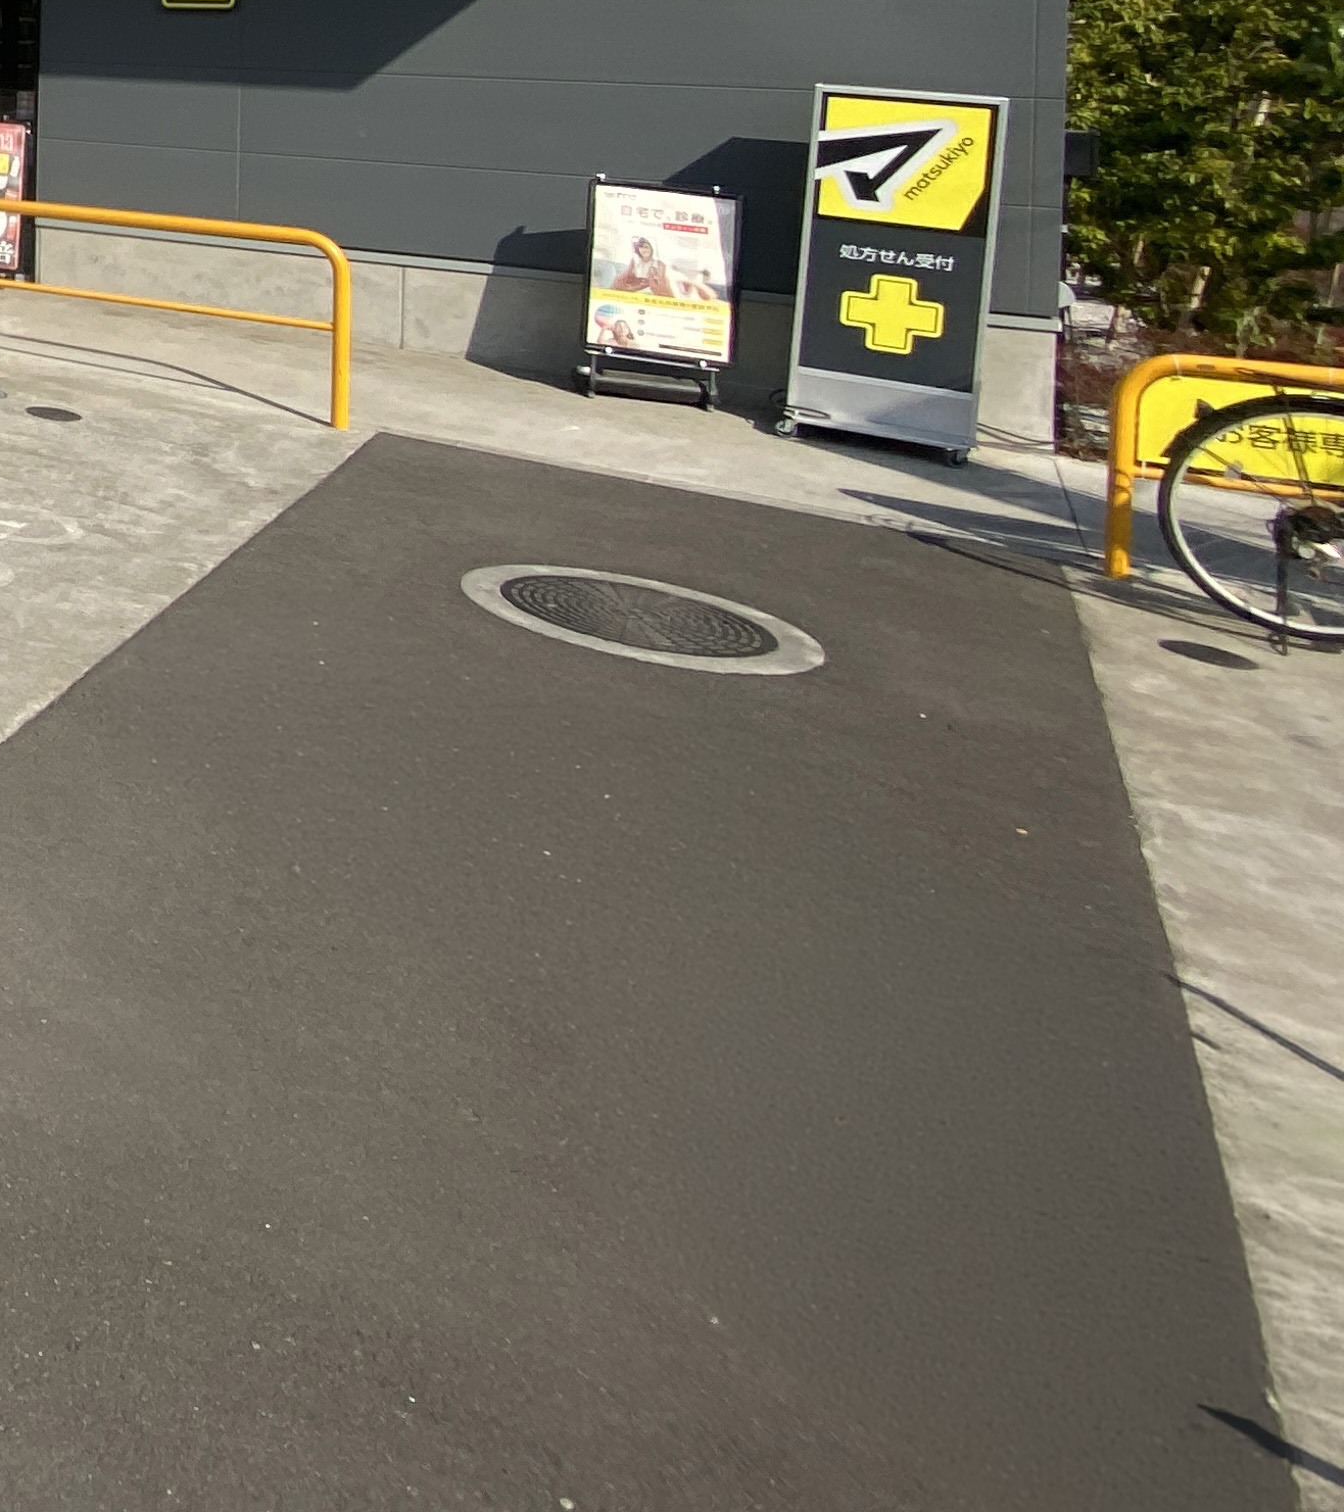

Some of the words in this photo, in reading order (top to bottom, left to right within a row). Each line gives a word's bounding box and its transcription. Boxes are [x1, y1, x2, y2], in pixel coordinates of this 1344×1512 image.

[904, 136, 975, 201] matsukiyo
[838, 244, 955, 272] 処方せん受付
